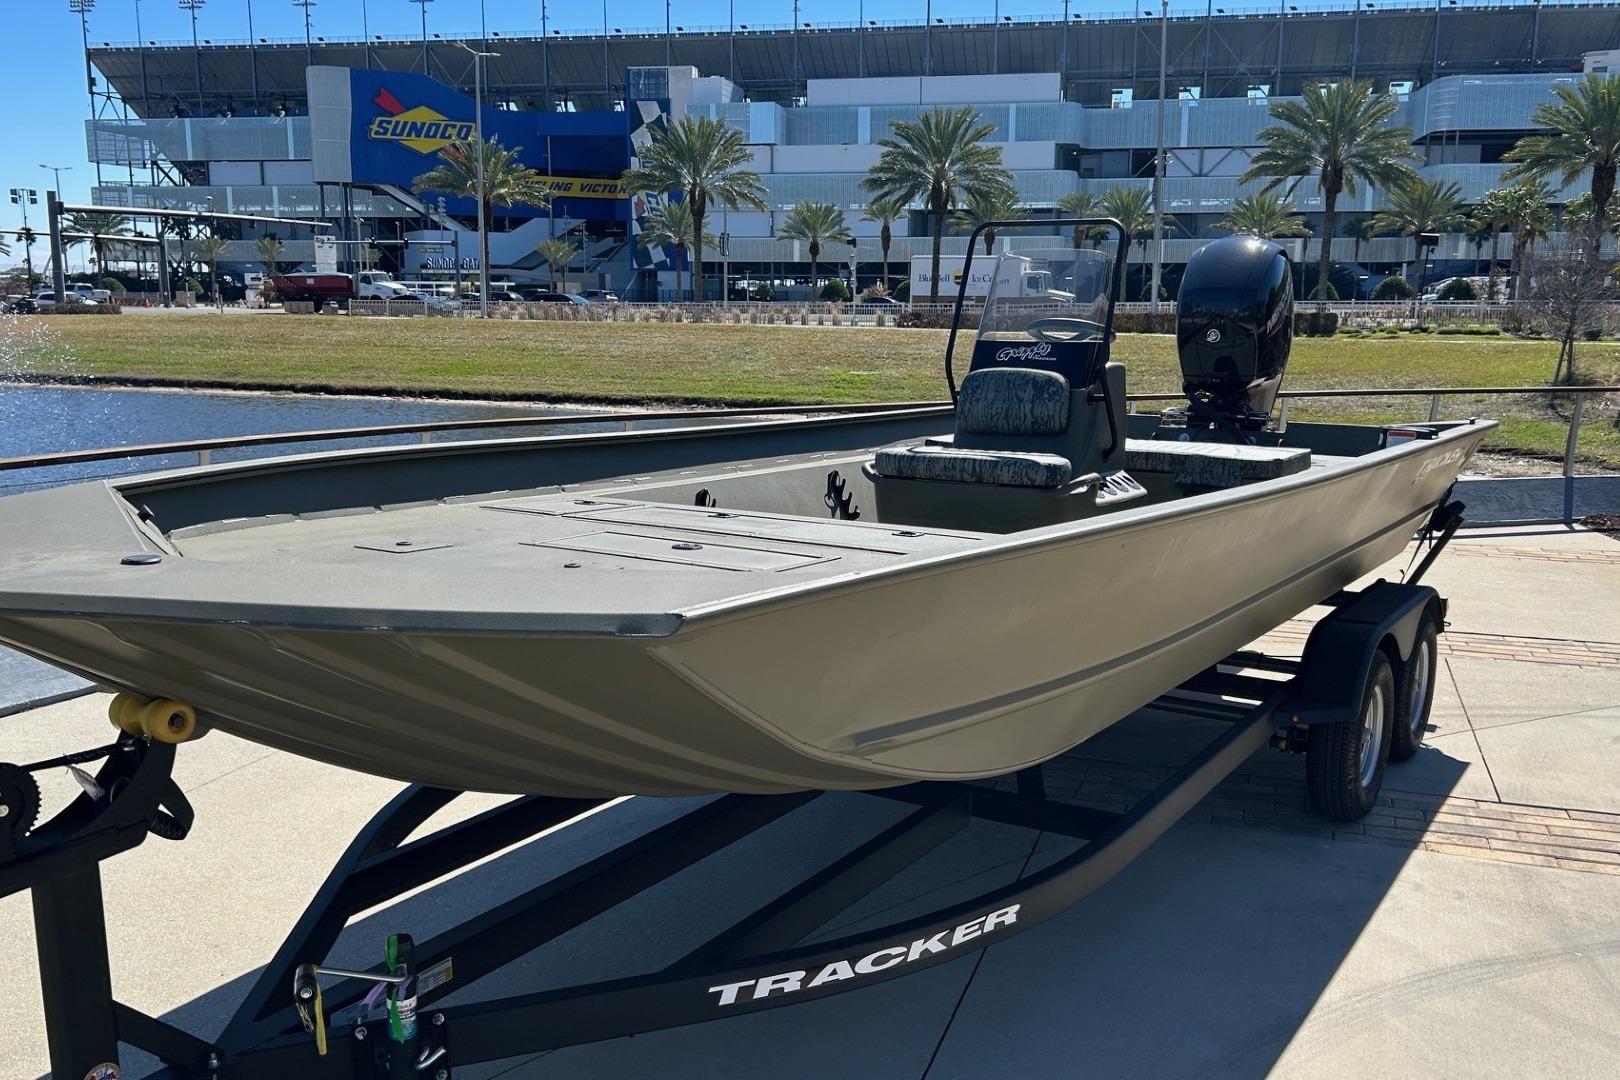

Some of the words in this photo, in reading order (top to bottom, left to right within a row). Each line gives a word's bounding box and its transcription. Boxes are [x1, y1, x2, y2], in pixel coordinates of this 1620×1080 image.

[373, 120, 474, 141] SUNOCO
[579, 182, 629, 195] VICTOR
[426, 256, 457, 269] SUNOC
[462, 256, 480, 269] GAT
[972, 274, 982, 282] Ice
[708, 904, 1021, 1006] TRACKER
